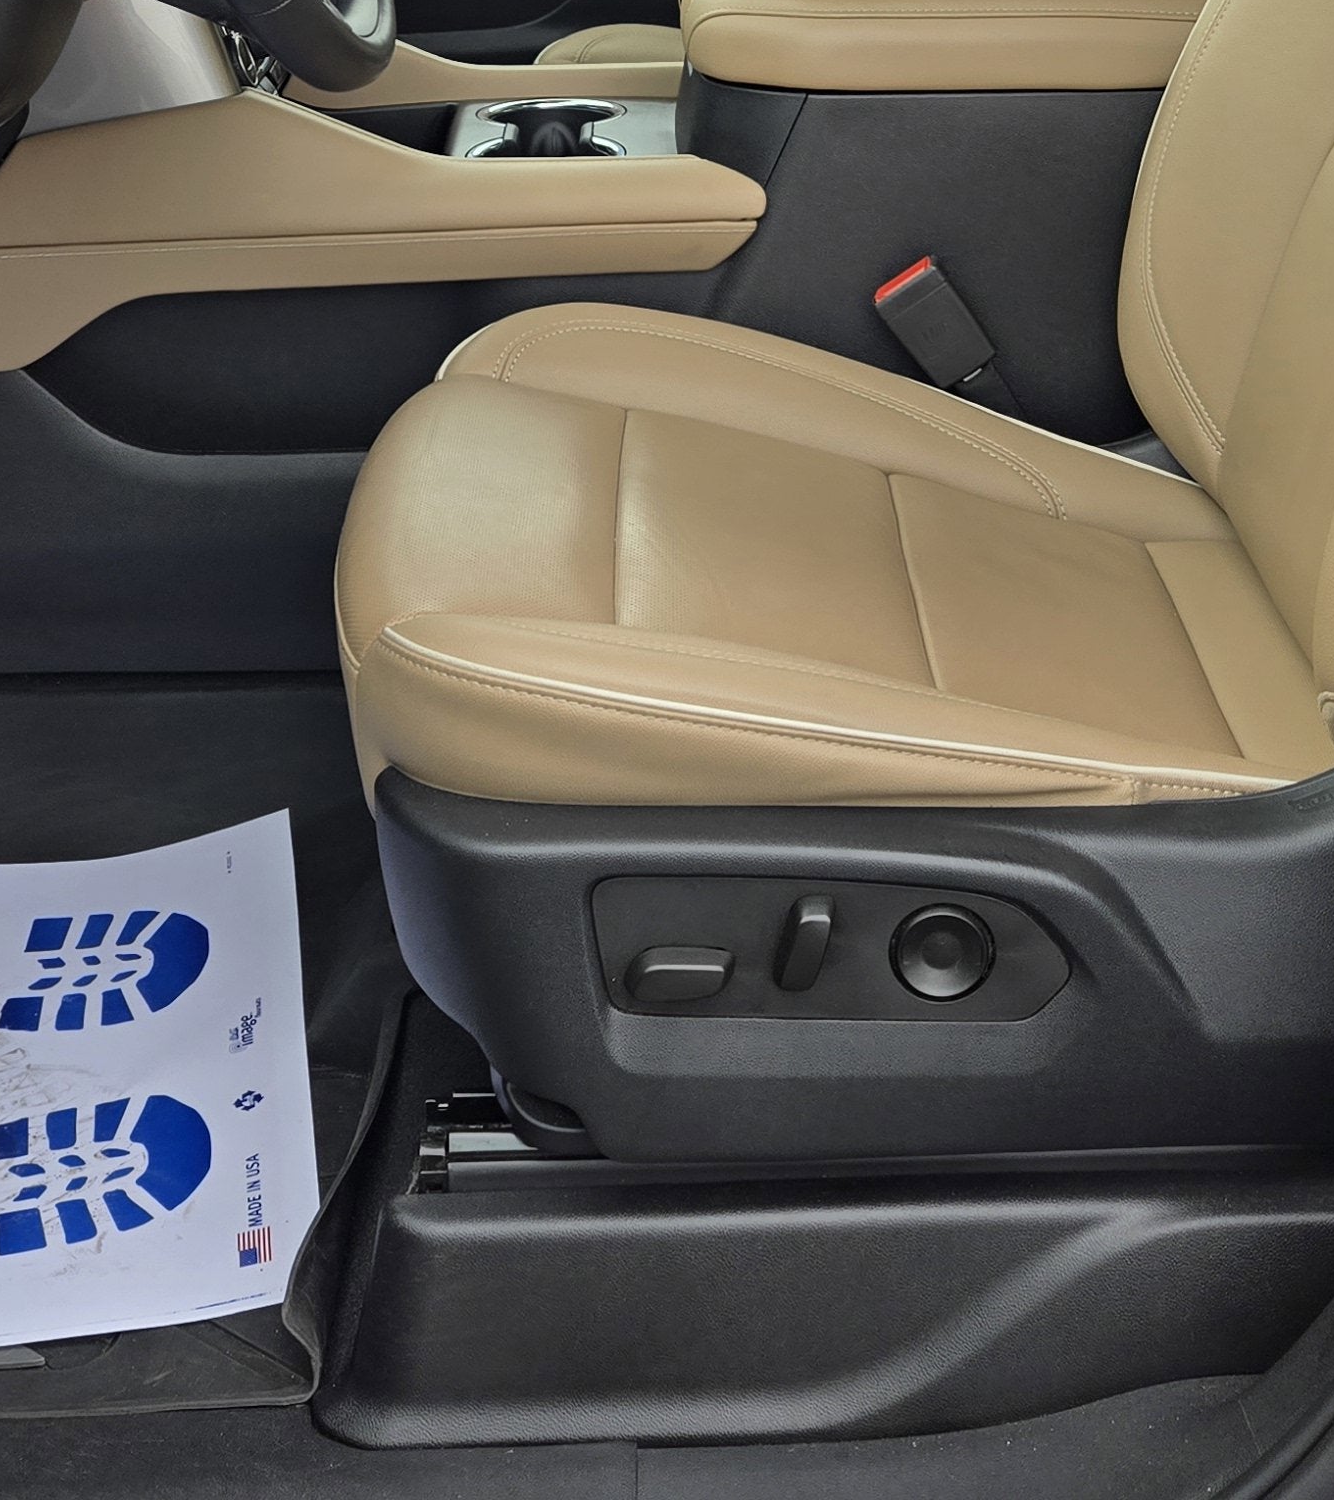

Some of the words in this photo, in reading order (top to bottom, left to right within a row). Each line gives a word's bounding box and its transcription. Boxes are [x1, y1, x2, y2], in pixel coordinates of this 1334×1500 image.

[245, 1153, 260, 1178] USA
[247, 1180, 261, 1193] IN
[247, 1194, 262, 1228] MADE
